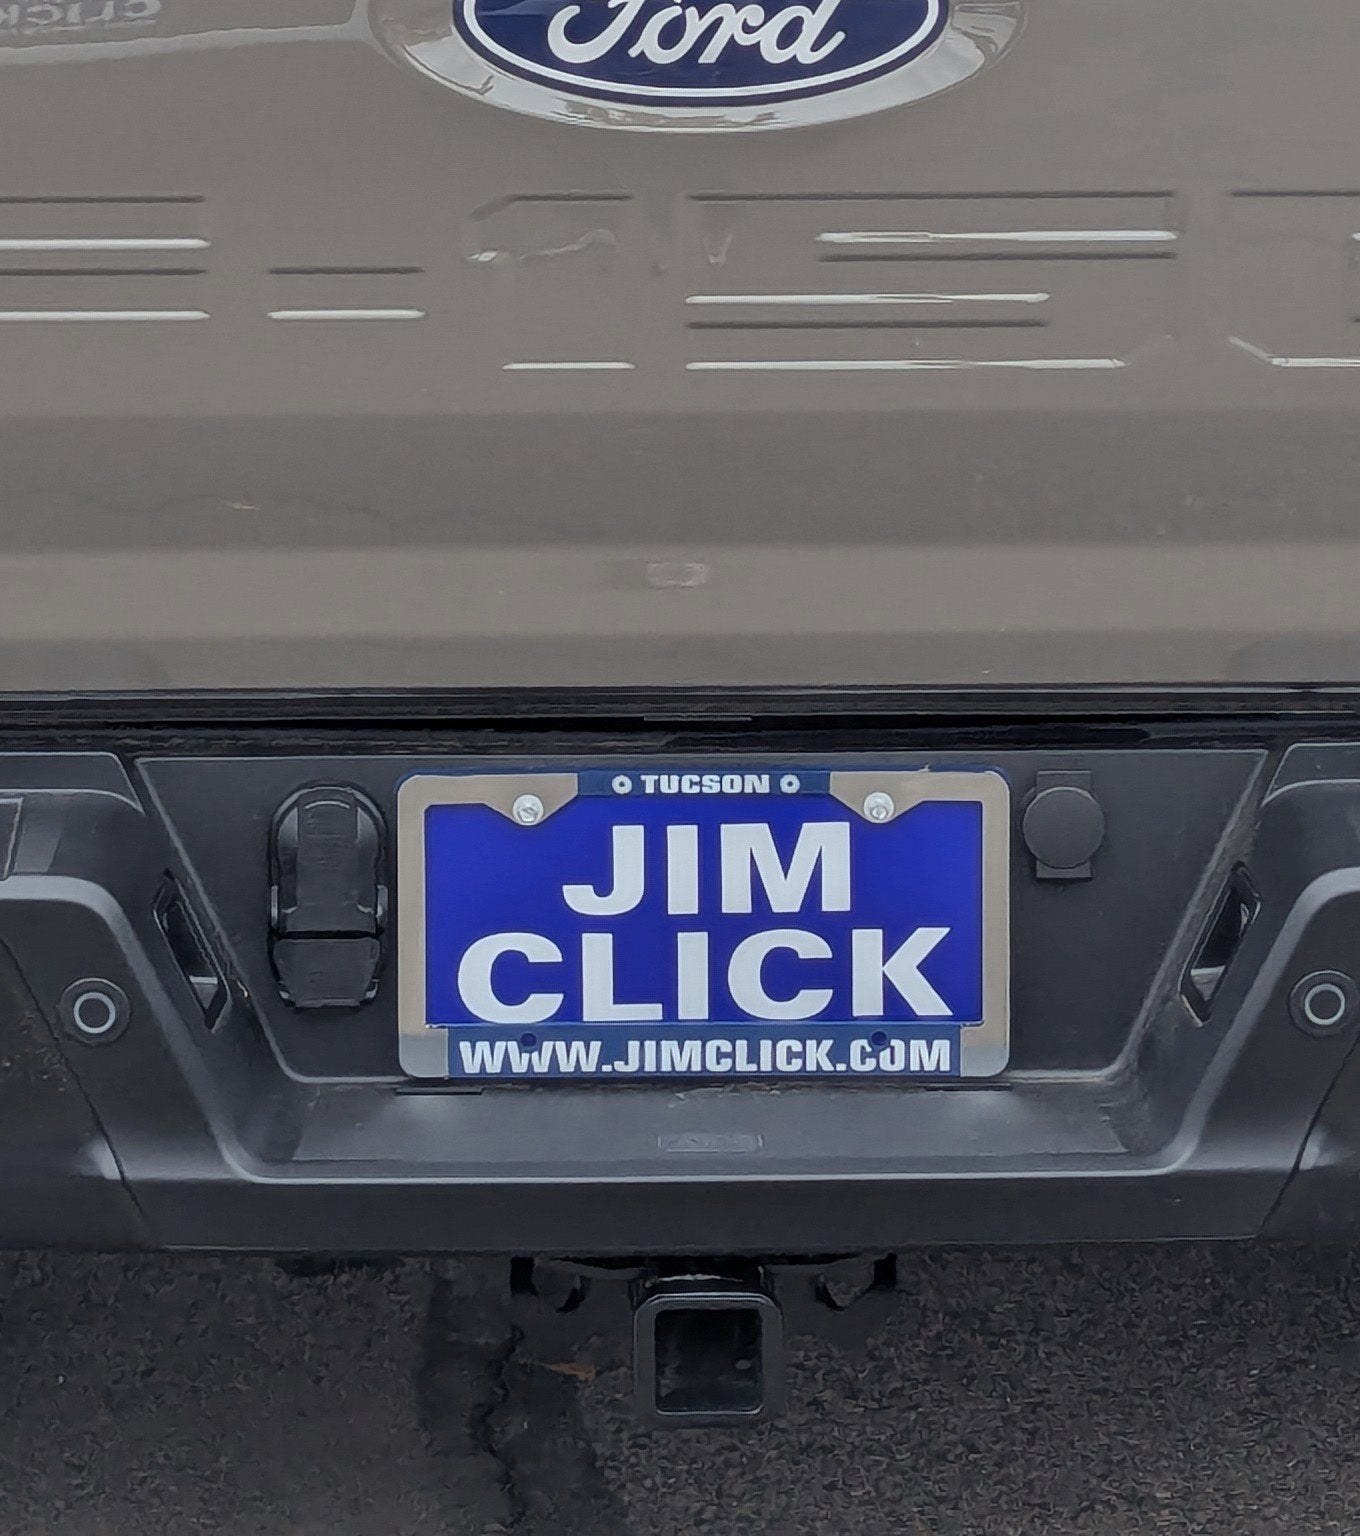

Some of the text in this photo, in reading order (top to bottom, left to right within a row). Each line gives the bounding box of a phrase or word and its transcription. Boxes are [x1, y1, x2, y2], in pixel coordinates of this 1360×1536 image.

[640, 774, 770, 794] TUCSON
[561, 821, 851, 916] JIM
[457, 926, 954, 1024] CLICK
[459, 1038, 951, 1074] WWW.JIMCLICK.COM
